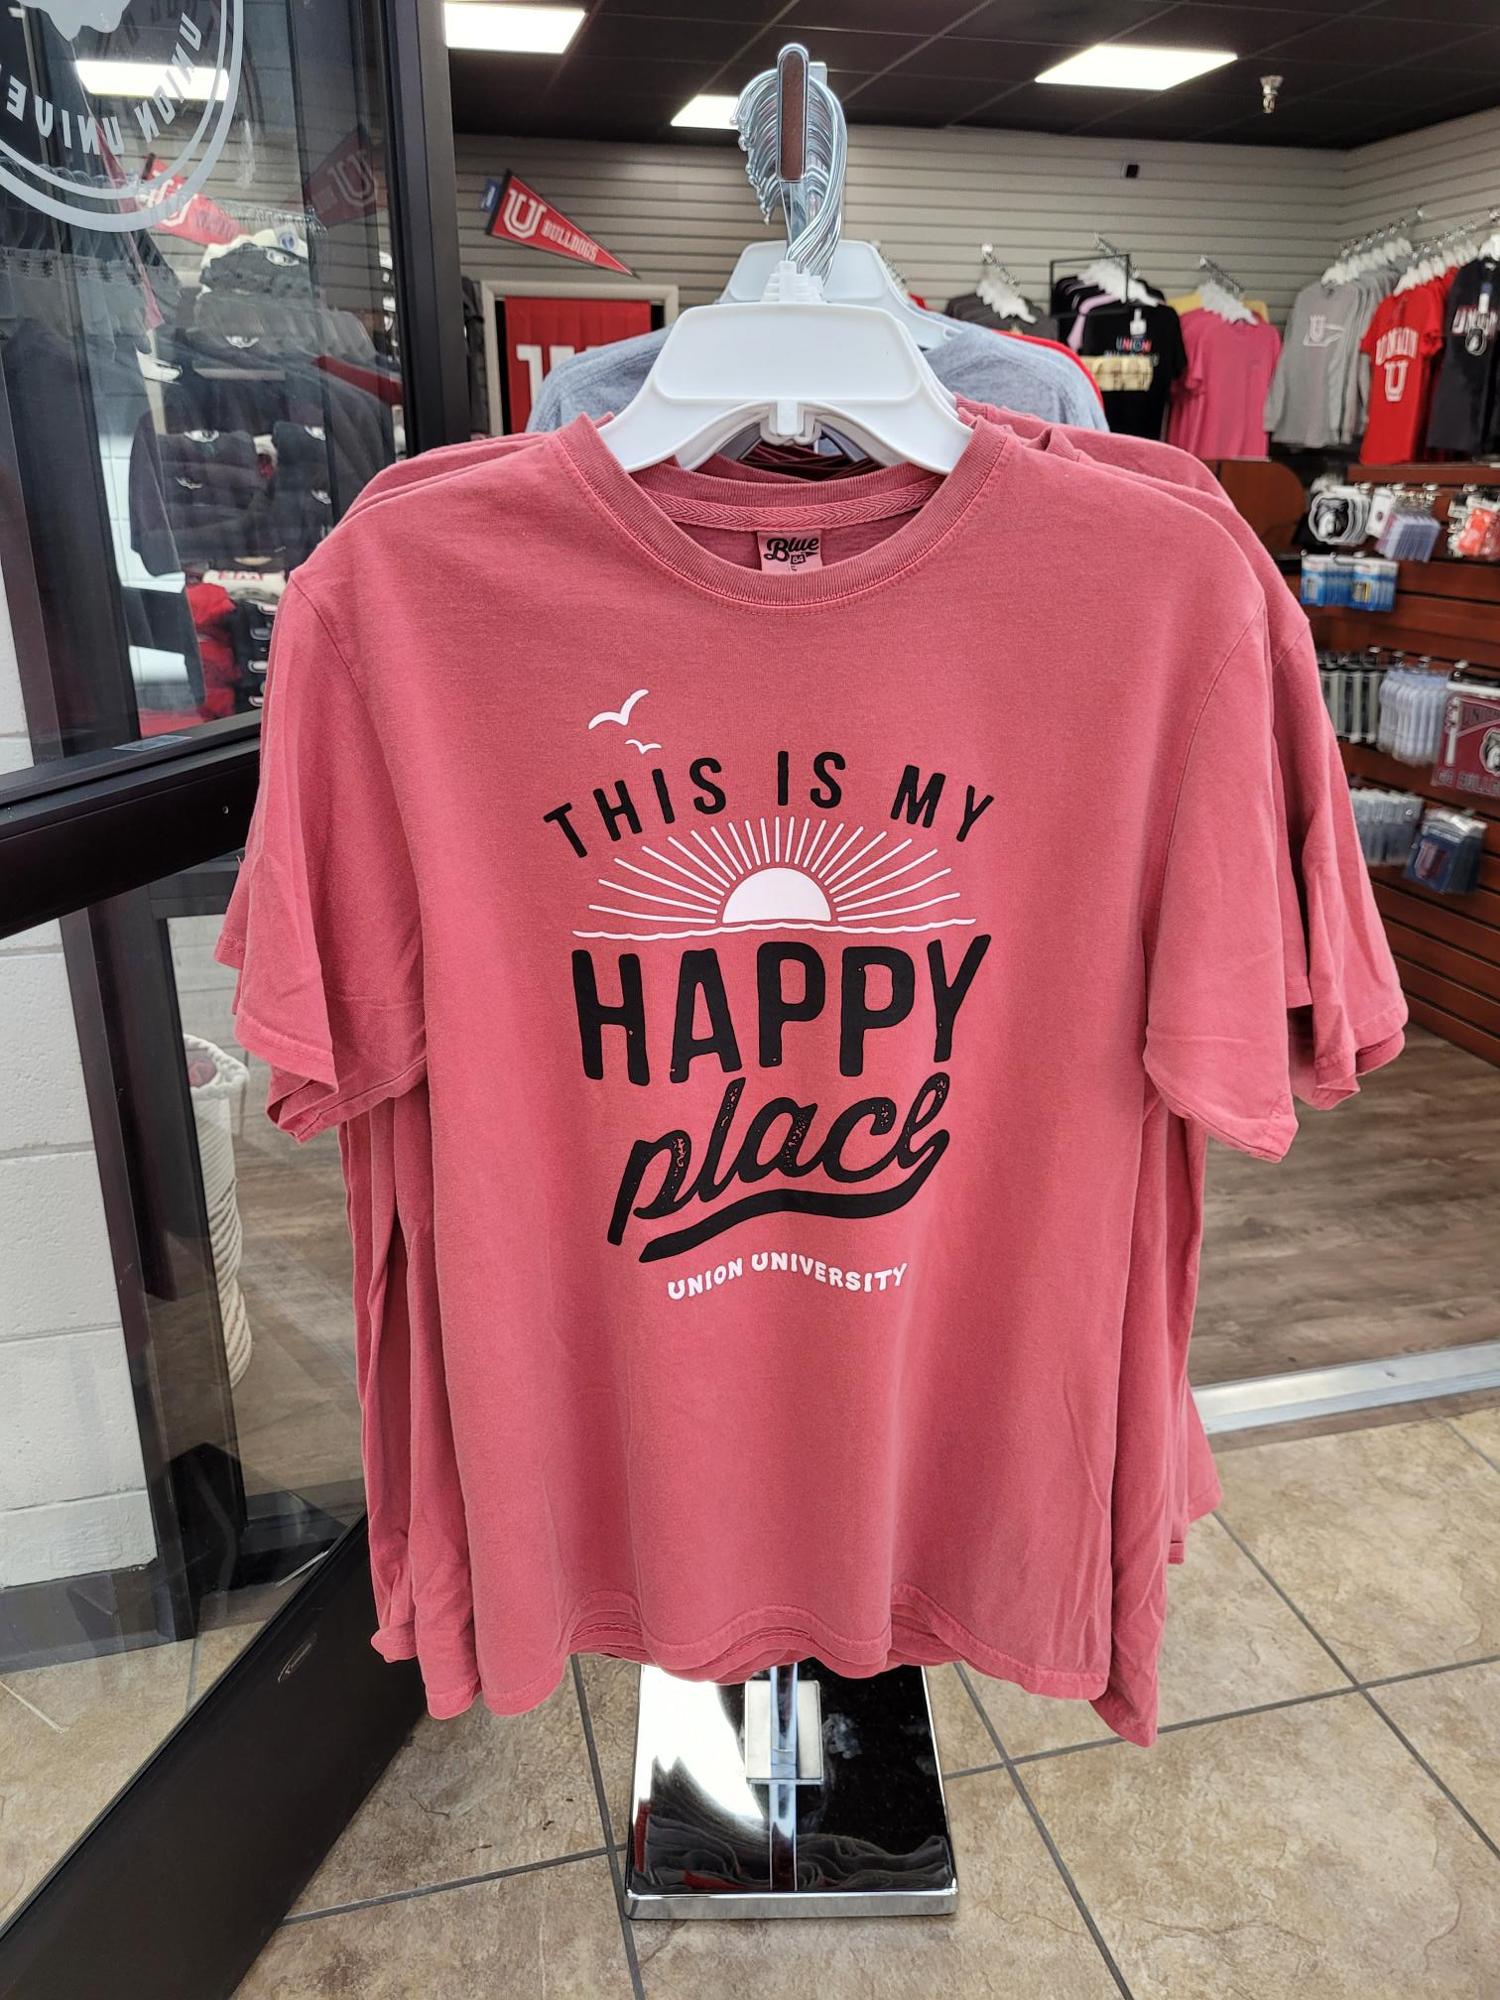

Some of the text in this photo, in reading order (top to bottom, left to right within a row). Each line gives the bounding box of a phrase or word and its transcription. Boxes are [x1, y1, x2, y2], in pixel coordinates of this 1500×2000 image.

[541, 219, 600, 263] BULLDOGS
[763, 537, 820, 562] Blue
[543, 751, 994, 858] THIS IS MY
[572, 934, 991, 1086] HAPPY
[607, 1071, 950, 1262] place
[667, 1252, 908, 1300] UNION UNIVERSITY
